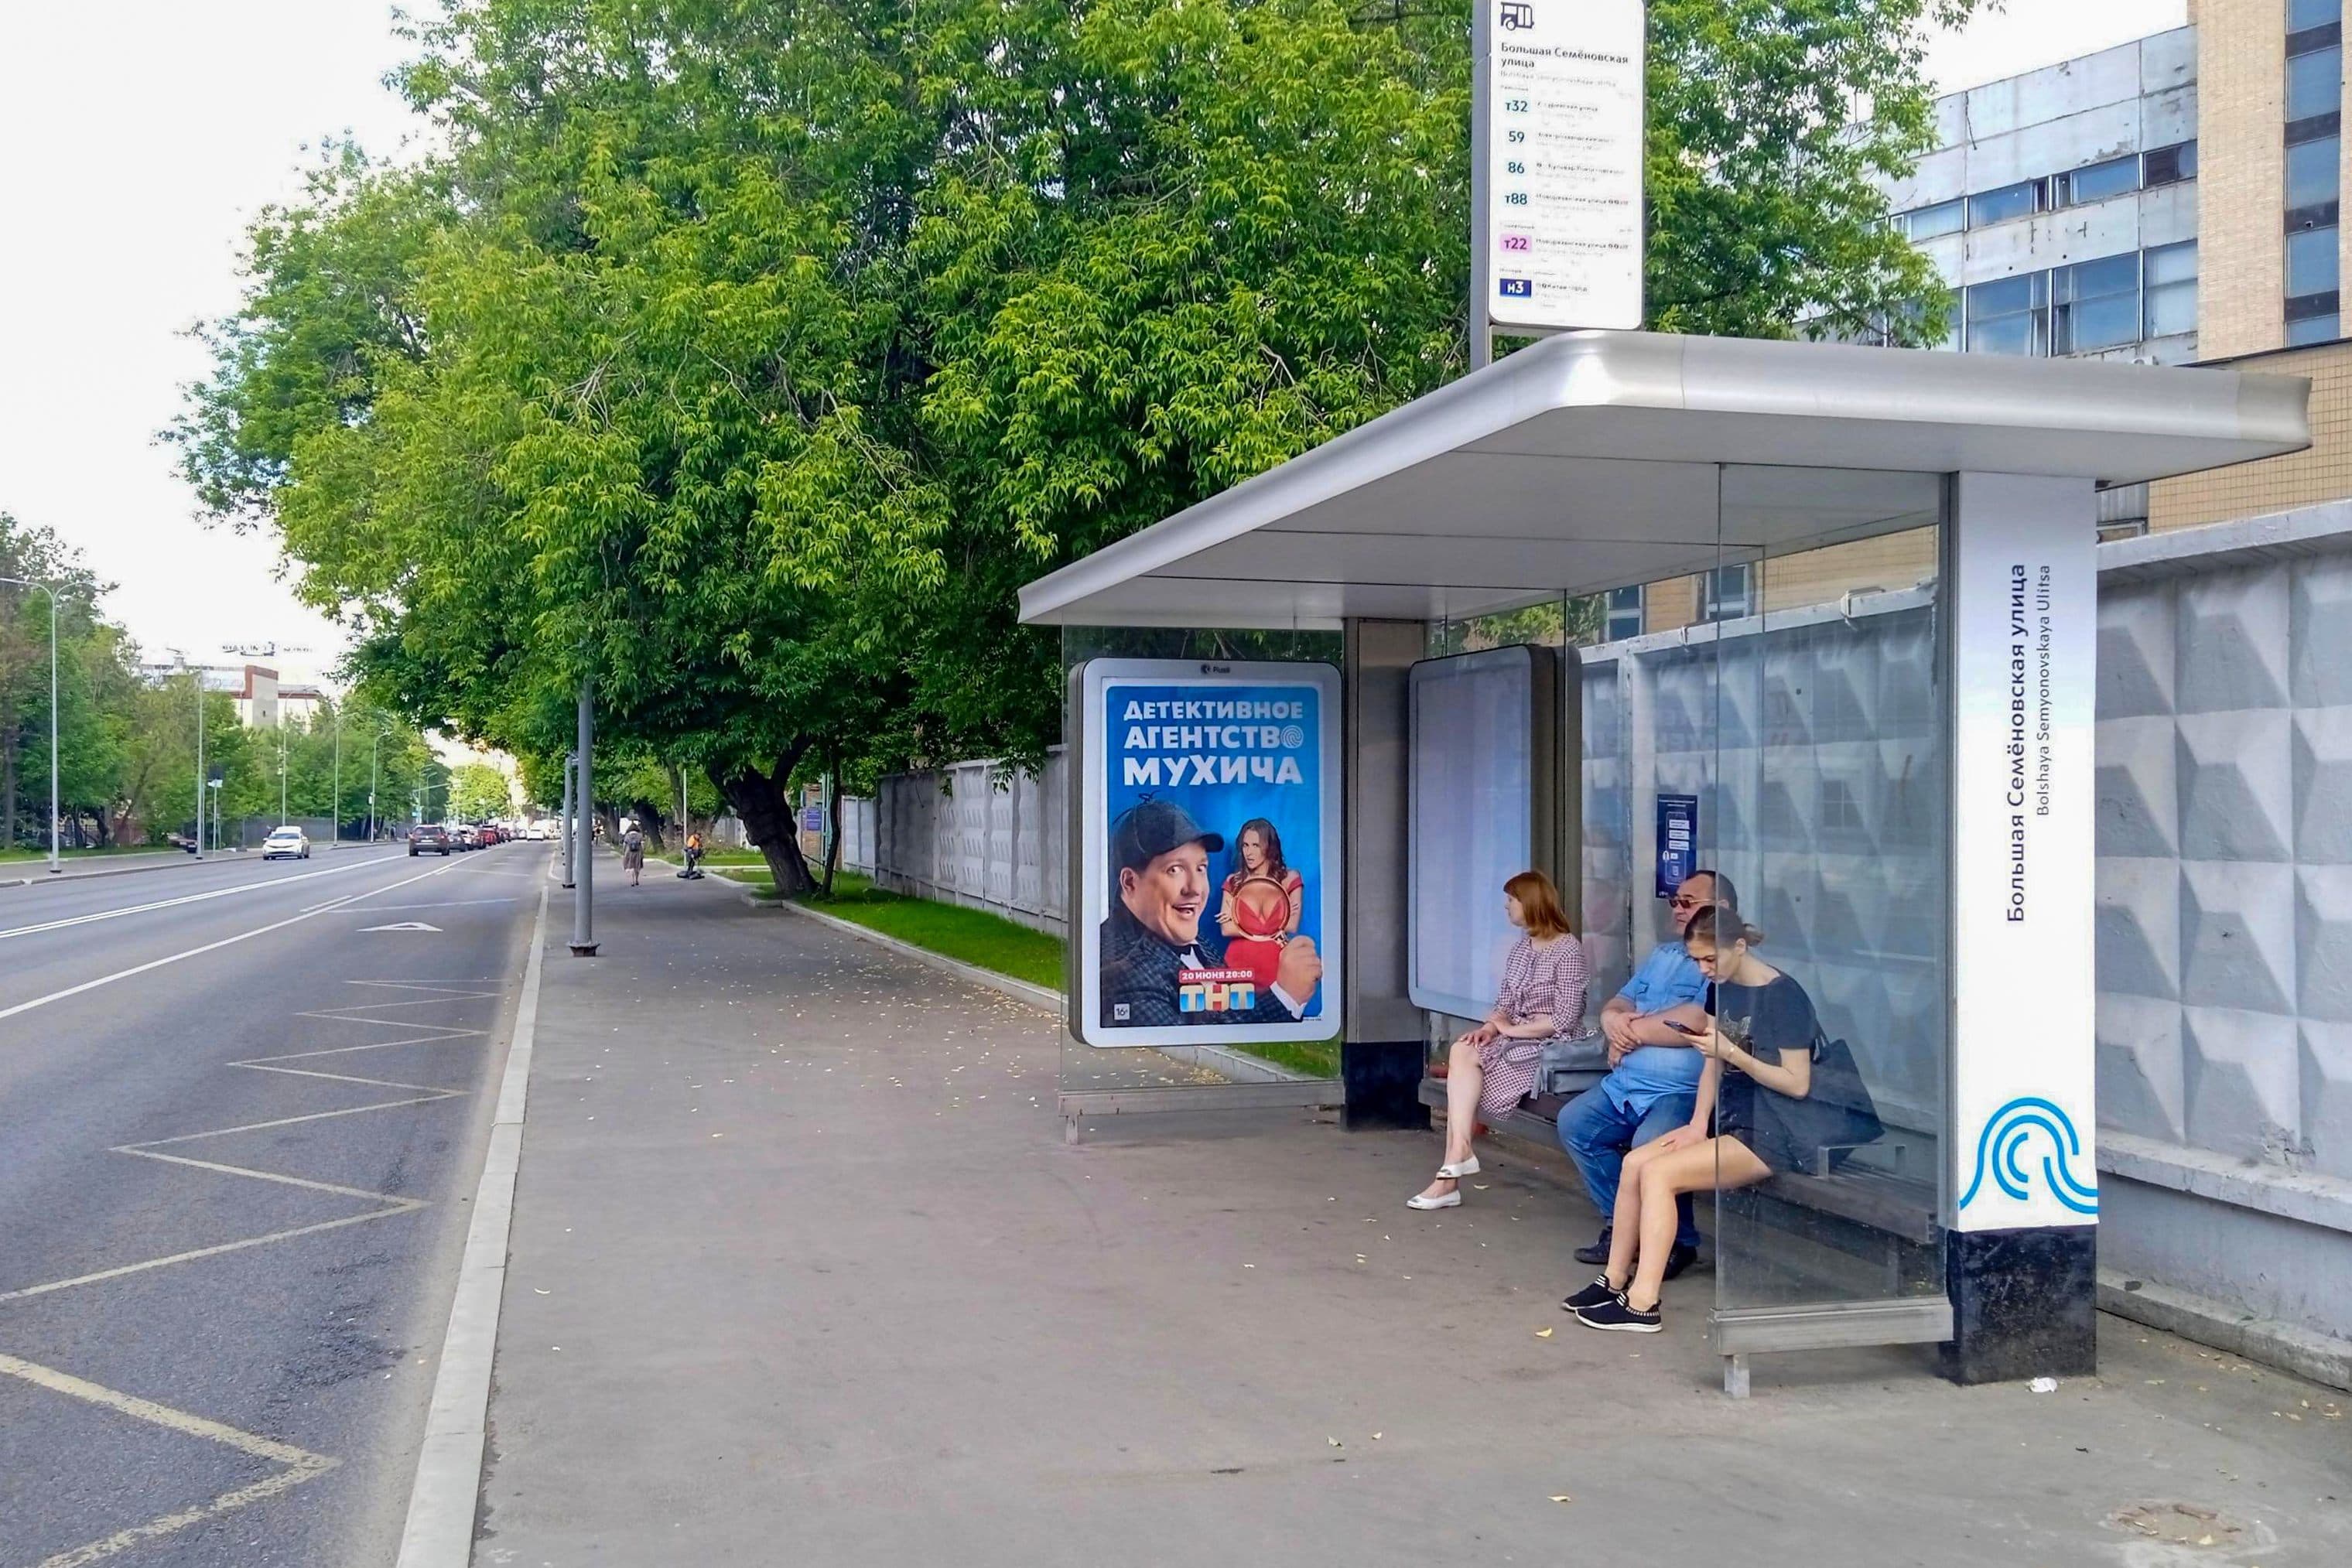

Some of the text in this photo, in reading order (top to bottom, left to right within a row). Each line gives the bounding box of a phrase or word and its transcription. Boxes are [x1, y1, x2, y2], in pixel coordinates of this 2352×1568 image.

[1500, 57, 1535, 68] улица
[1501, 42, 1629, 64] Большая Семёновская
[1508, 130, 1525, 143] 59
[1508, 161, 1525, 174] 86
[2036, 565, 2053, 816] Bolshaya Semyonovskaya Ulitsa
[1123, 701, 1303, 721] ДЕТЕКТИВНОЕ
[1123, 725, 1304, 749] АГЕНТСТВО
[2006, 564, 2029, 922] Большая Семёновская улица
[1123, 754, 1304, 787] МУХИЧА
[1181, 970, 1253, 980] 20 ИЮНЯ 20:00
[1179, 983, 1255, 1013] ТНТ
